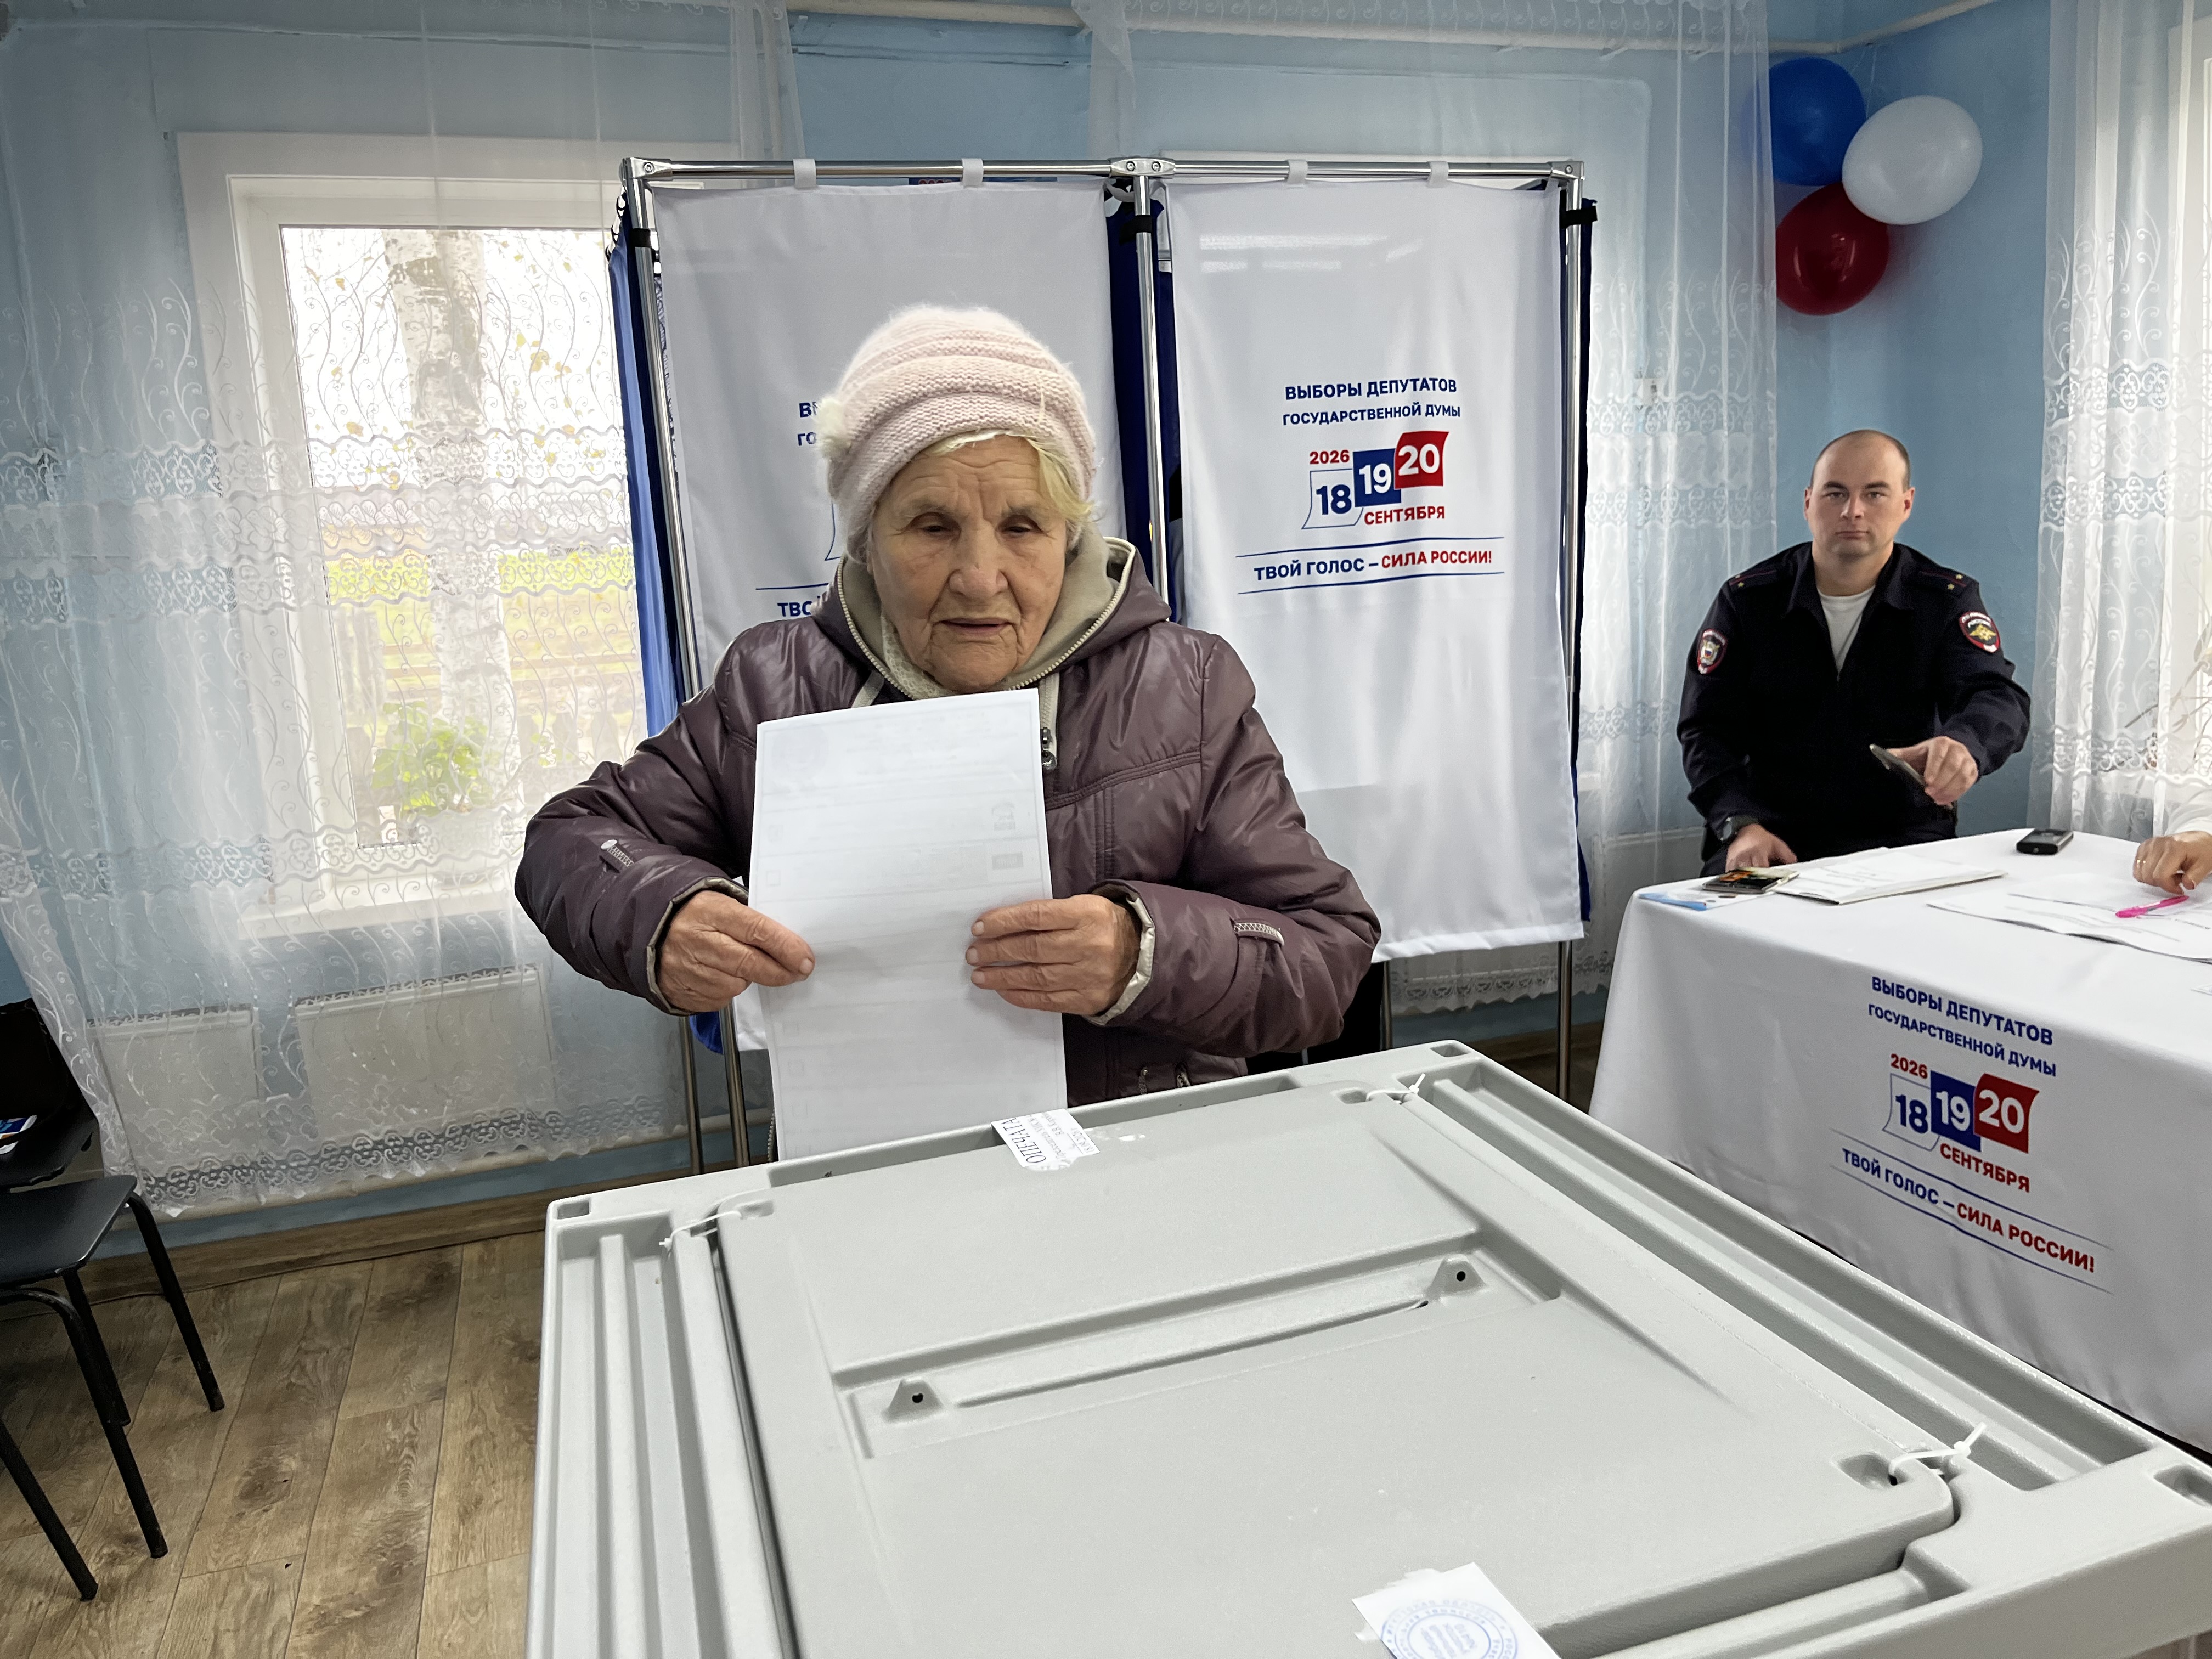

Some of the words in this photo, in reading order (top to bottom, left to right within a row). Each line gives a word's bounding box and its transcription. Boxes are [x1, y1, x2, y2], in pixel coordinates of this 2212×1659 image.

[1285, 383, 1362, 400] ВЫБОРЫ
[1367, 378, 1456, 397] ДЕПУТАТОВ
[1283, 402, 1421, 425] ГОСУДАРСТВЕННОЙ
[1425, 404, 1460, 417] ДУМЫ
[1310, 450, 1350, 464] 2026
[1316, 484, 1352, 515] 18
[1358, 462, 1392, 495] 19
[1397, 443, 1440, 476] 20
[1364, 506, 1444, 525] СЕНТЯБРЯ
[1254, 560, 1301, 580] ТВОЙ
[1307, 558, 1364, 575] ГОЛОС
[1382, 551, 1427, 568] СИЛА
[1431, 551, 1491, 563] РОССИИ!
[1872, 977, 1942, 1012] ВЫБОРЫ
[1946, 1000, 2052, 1045] ДЕПУТАТОВ
[1869, 1004, 2004, 1061] ГОСУДАРСТВЕННОЙ
[2008, 1051, 2056, 1076] ДУМЫ
[1891, 1053, 1927, 1079] 2026
[1895, 1094, 1928, 1133] 18
[1936, 1090, 1971, 1132] 19
[1978, 1088, 2025, 1135] 20
[1940, 1143, 2029, 1193] СЕНТЯБРЯ
[1842, 1148, 1880, 1178] ТВОЙ
[1885, 1169, 1938, 1204] ГОЛОС
[1957, 1203, 2004, 1236] СИЛА
[2009, 1224, 2094, 1273] РОССИИ!
